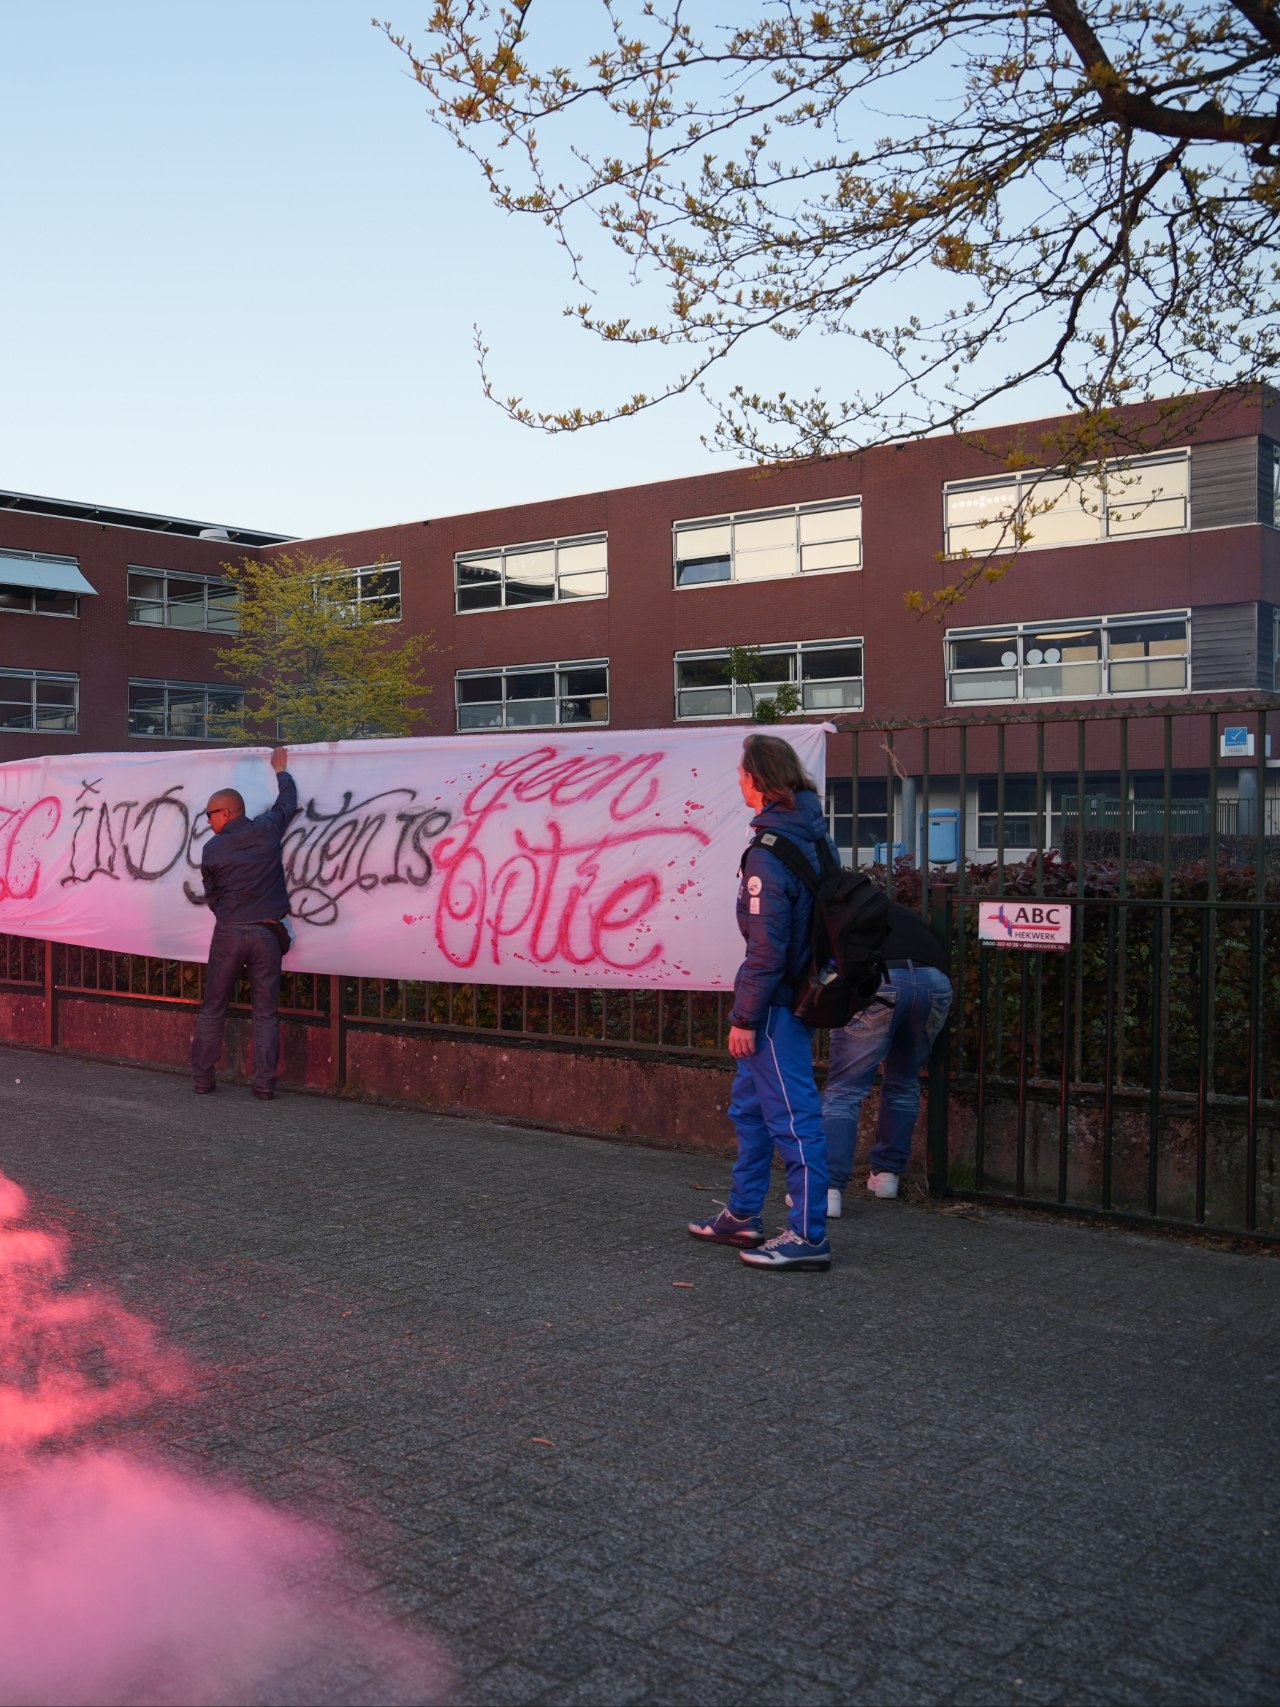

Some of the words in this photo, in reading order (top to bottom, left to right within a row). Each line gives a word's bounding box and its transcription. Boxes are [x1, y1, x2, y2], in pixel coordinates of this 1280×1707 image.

[434, 746, 664, 868] geen
[1014, 907, 1060, 925] ABC
[1014, 931, 1056, 941] HEKWERK
